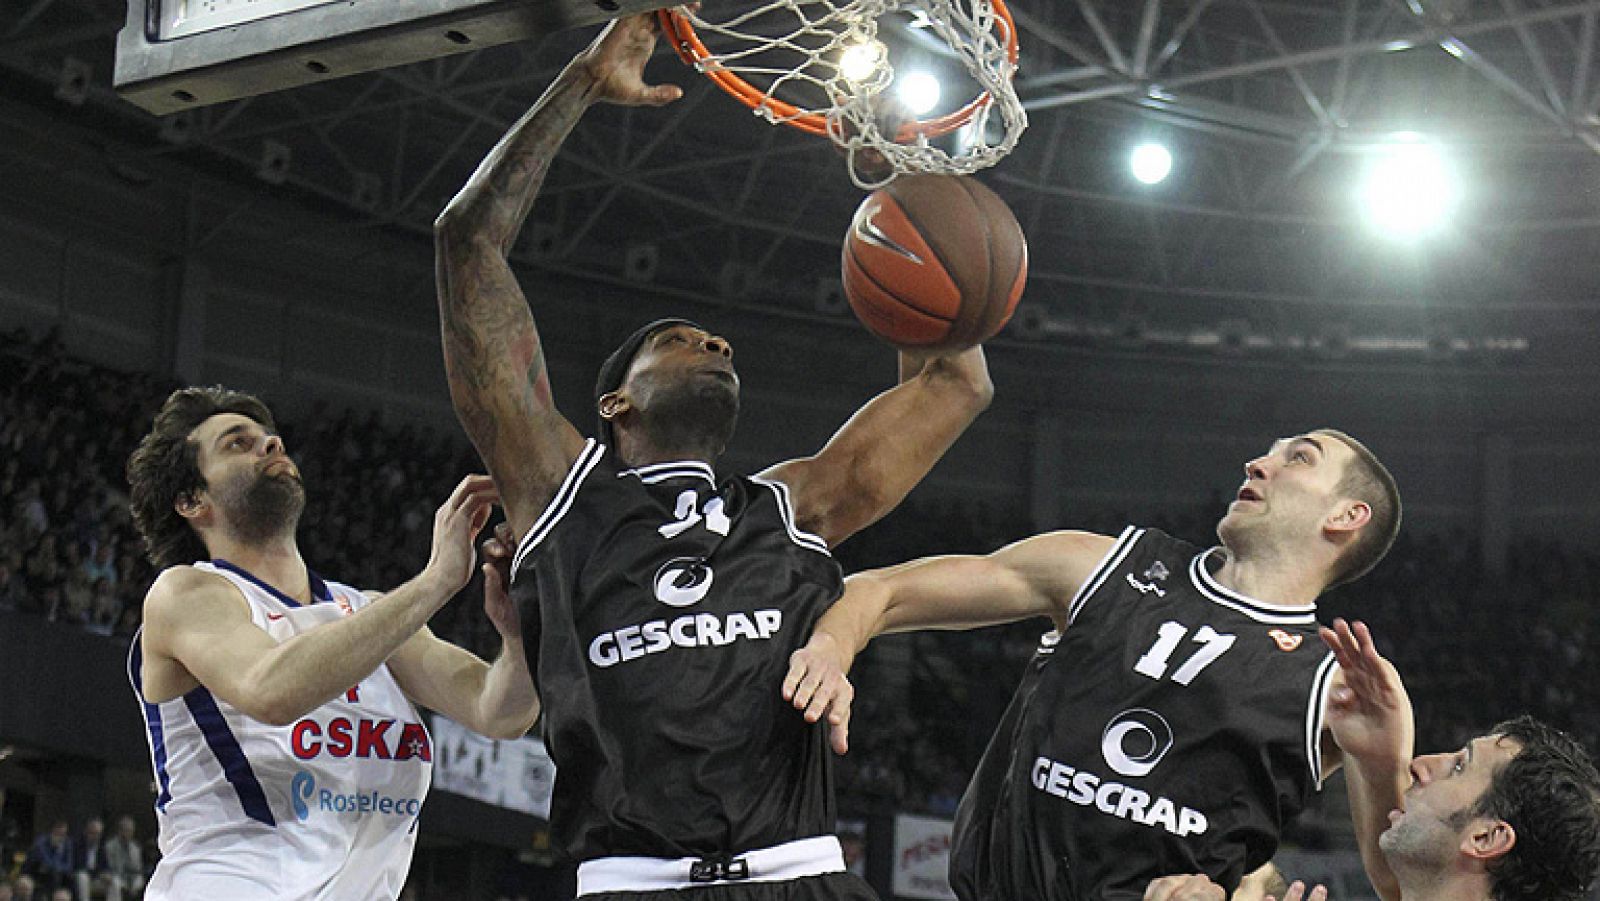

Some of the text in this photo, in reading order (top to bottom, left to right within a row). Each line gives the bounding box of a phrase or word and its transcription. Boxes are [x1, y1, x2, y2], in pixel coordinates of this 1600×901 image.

[589, 610, 781, 667] GESCRAP
[1134, 622, 1237, 685] 17
[292, 718, 431, 760] CSKA
[1032, 758, 1208, 837] GESCRAP
